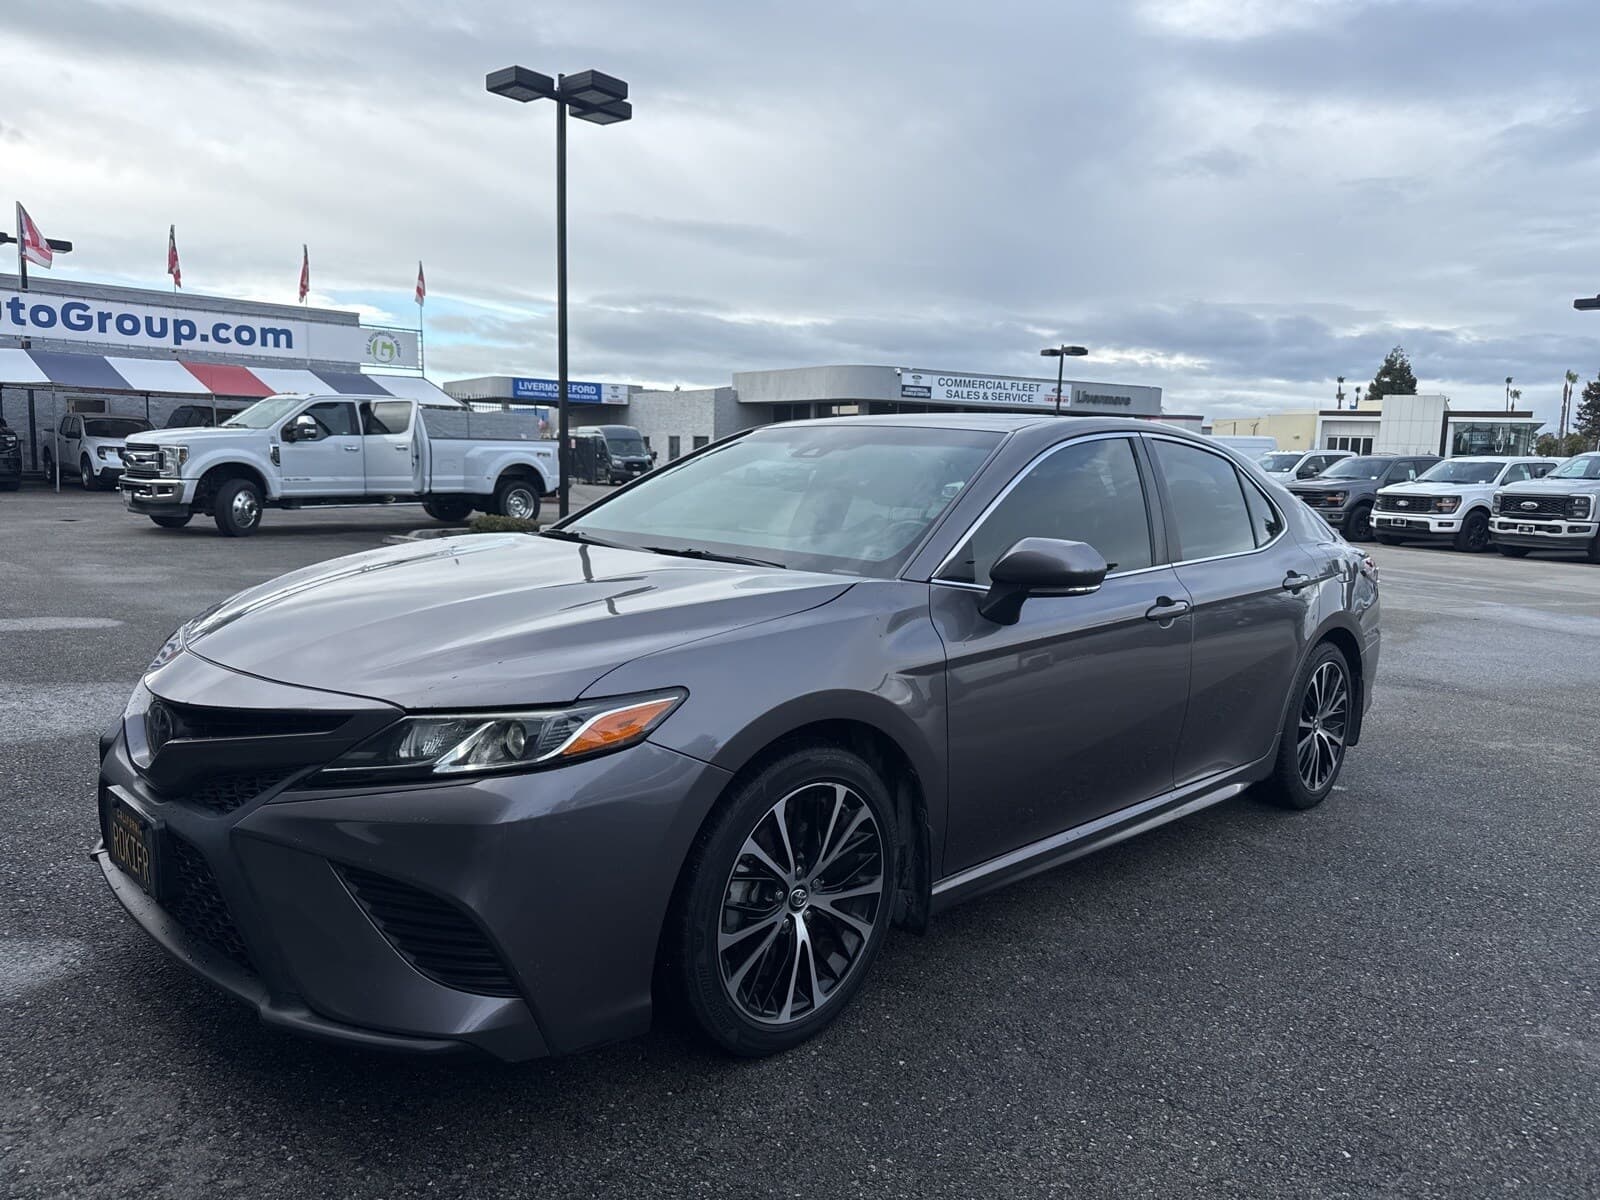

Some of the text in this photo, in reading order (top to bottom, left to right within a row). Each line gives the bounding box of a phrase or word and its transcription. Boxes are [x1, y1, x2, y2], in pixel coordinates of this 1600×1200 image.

[0, 296, 293, 349] toGroup.com
[518, 381, 570, 393] LIVERMOE
[571, 384, 597, 395] FORD
[937, 377, 1042, 393] COMMERCIAL FLEET
[945, 389, 980, 400] SALES
[982, 391, 989, 400] &
[991, 391, 1034, 403] SERVICE
